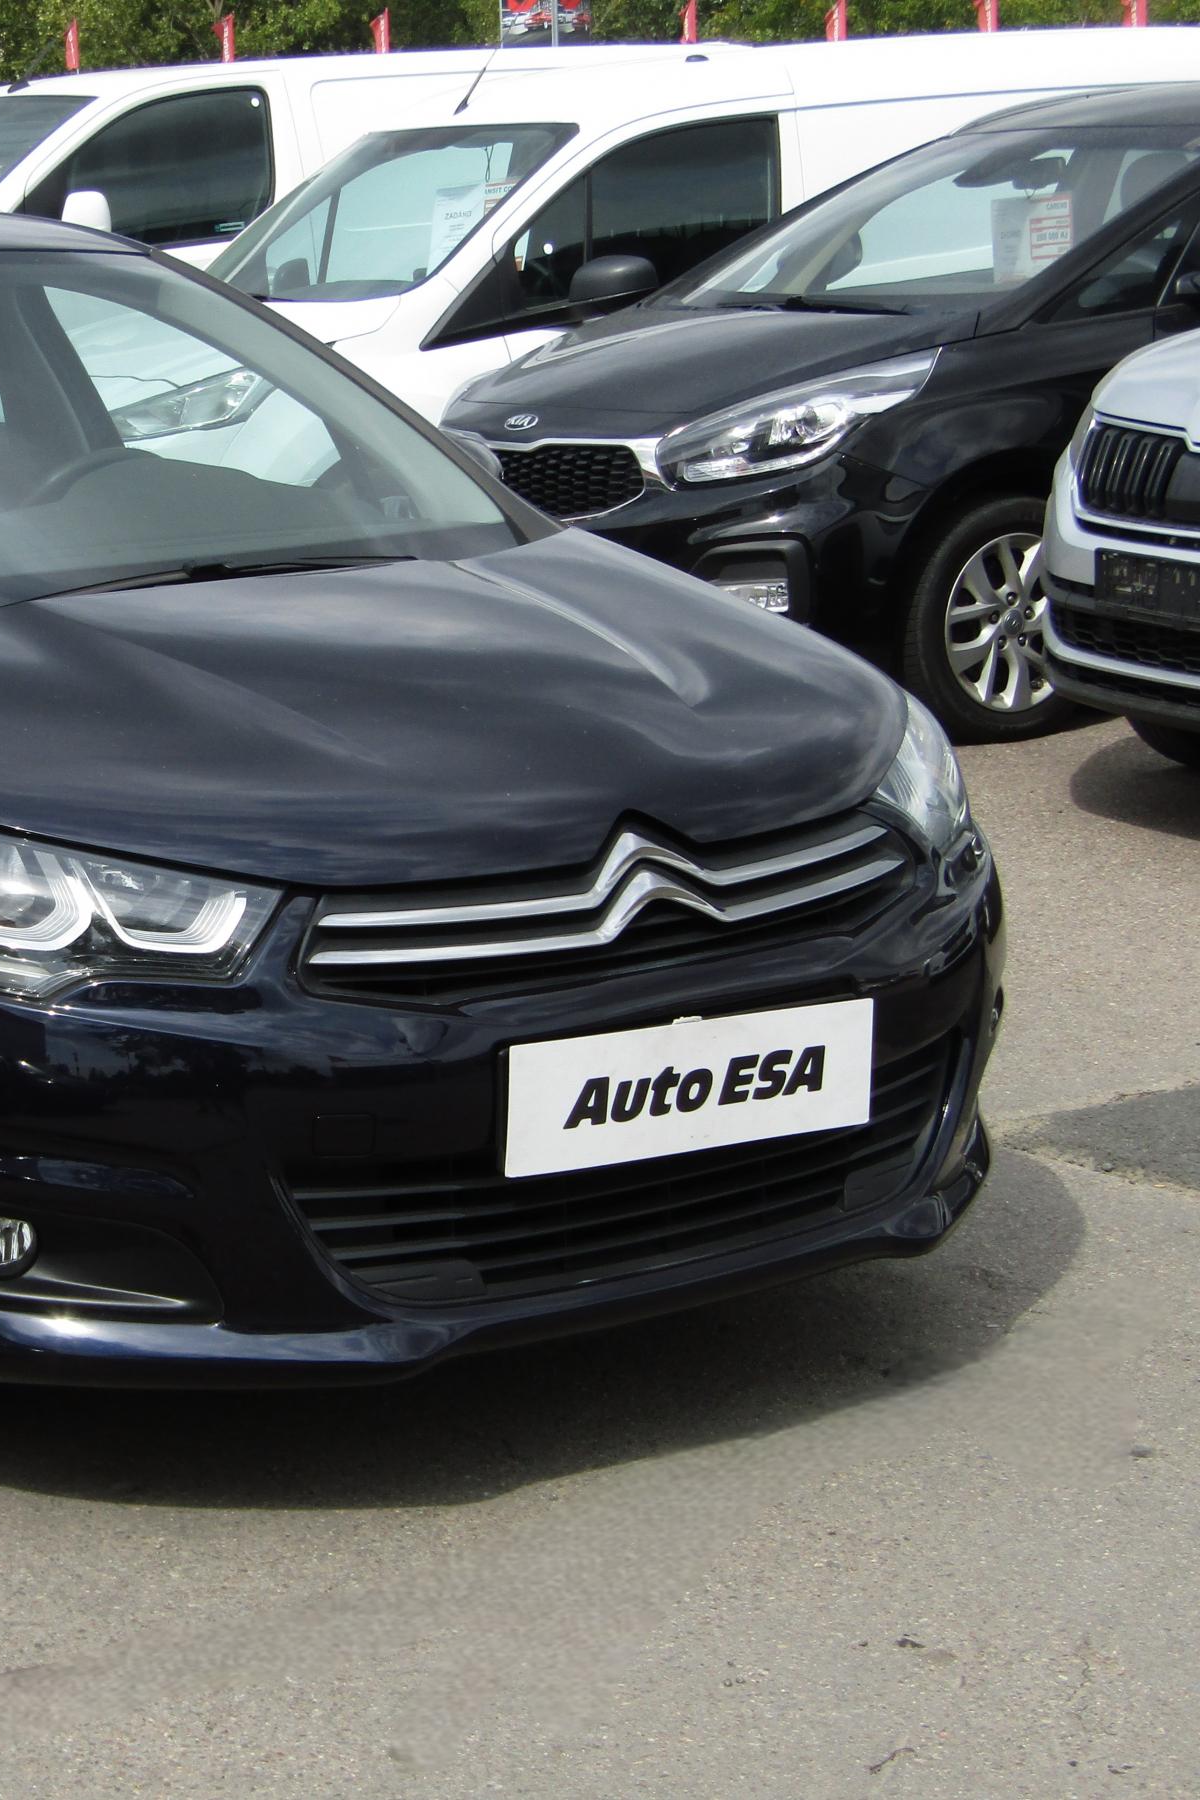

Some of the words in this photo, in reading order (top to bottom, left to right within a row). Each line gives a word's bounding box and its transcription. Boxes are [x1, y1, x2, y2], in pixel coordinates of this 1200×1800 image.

[505, 415, 535, 428] KIA
[563, 1066, 713, 1130] Auto
[717, 1045, 826, 1106] ESA
